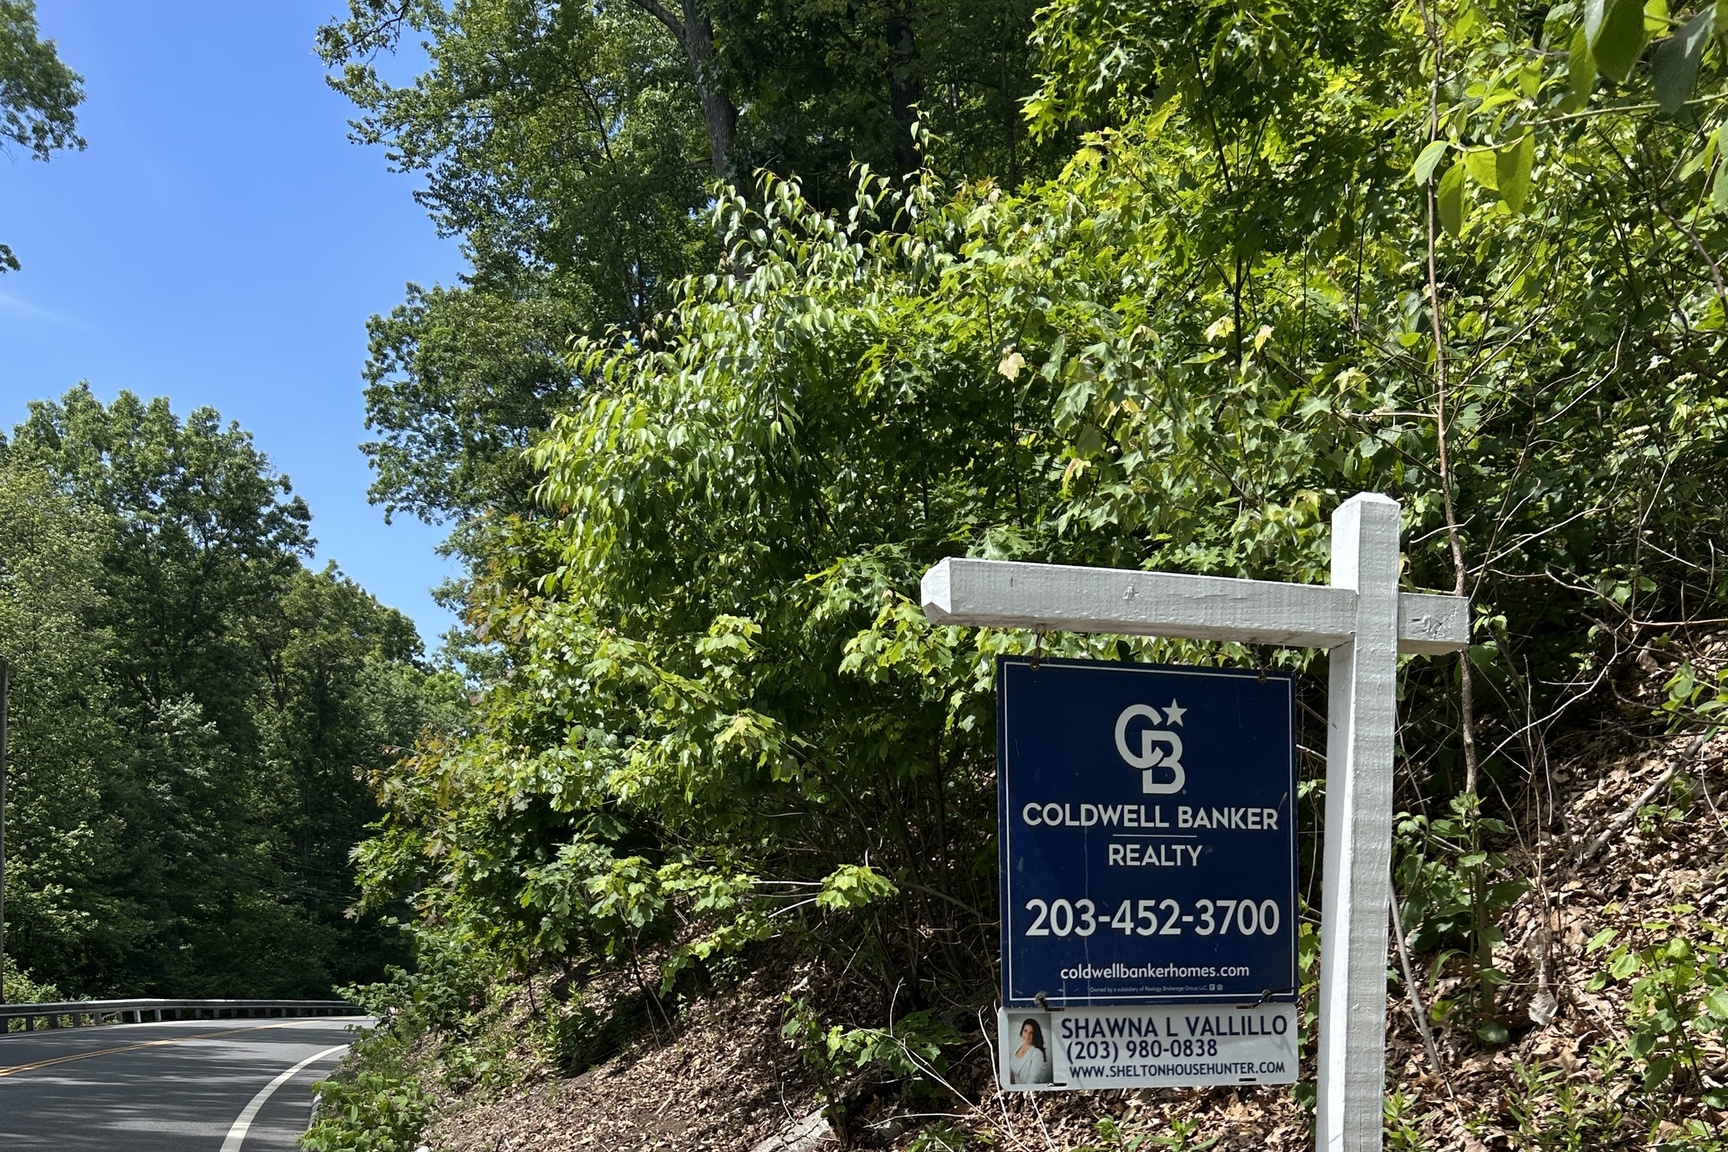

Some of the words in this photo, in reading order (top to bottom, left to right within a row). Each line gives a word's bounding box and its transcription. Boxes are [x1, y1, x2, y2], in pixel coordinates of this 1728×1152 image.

[1114, 703, 1186, 794] CB
[1022, 802, 1170, 828] COLDWELL
[1177, 806, 1278, 830] BANKER
[1108, 844, 1203, 867] REALTY
[1024, 898, 1280, 937] 203-452-3700
[1059, 962, 1250, 980] coldwellbankerhomes.com
[1061, 1016, 1158, 1040] SHAWNA
[1166, 1016, 1179, 1037] L
[1185, 1014, 1288, 1037] VALLILLO
[1066, 1040, 1120, 1064] (203)
[1127, 1038, 1218, 1059] 980-0838
[1069, 1061, 1285, 1078] WWW.SHELTONHOUSEHUNTER.COM
